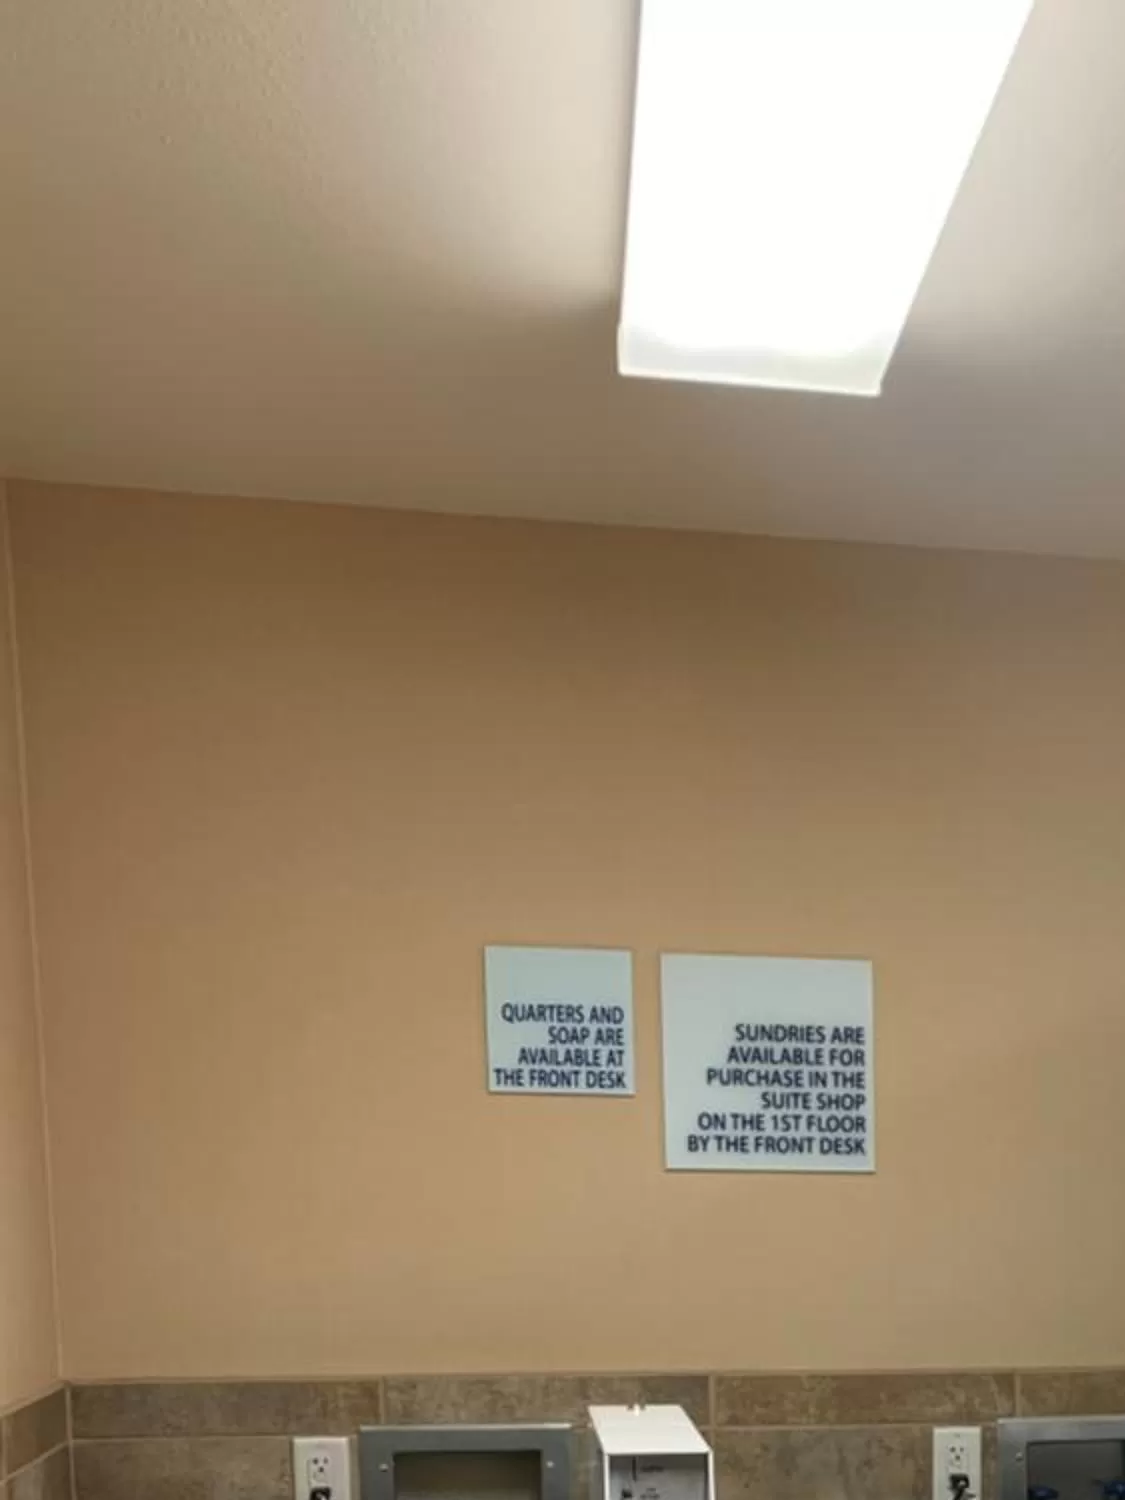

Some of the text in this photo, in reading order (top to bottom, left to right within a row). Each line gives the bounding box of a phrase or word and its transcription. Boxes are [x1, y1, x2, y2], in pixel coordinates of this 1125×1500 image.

[501, 1002, 624, 1024] QUARTERS AND
[548, 1027, 624, 1045] SOAP ARE
[735, 1024, 865, 1045] SUNDRIES ARE
[518, 1048, 624, 1067] AVAILABLE AT
[727, 1047, 865, 1066] AVAILABLE FOR
[494, 1068, 626, 1088] THE FRONT DESK
[706, 1068, 865, 1088] PURCHASE IN THE
[761, 1092, 866, 1111] SUITE SHOP
[698, 1112, 866, 1132] ON THE 1ST FLOOR
[687, 1135, 865, 1155] BY THE FRONT DESK
